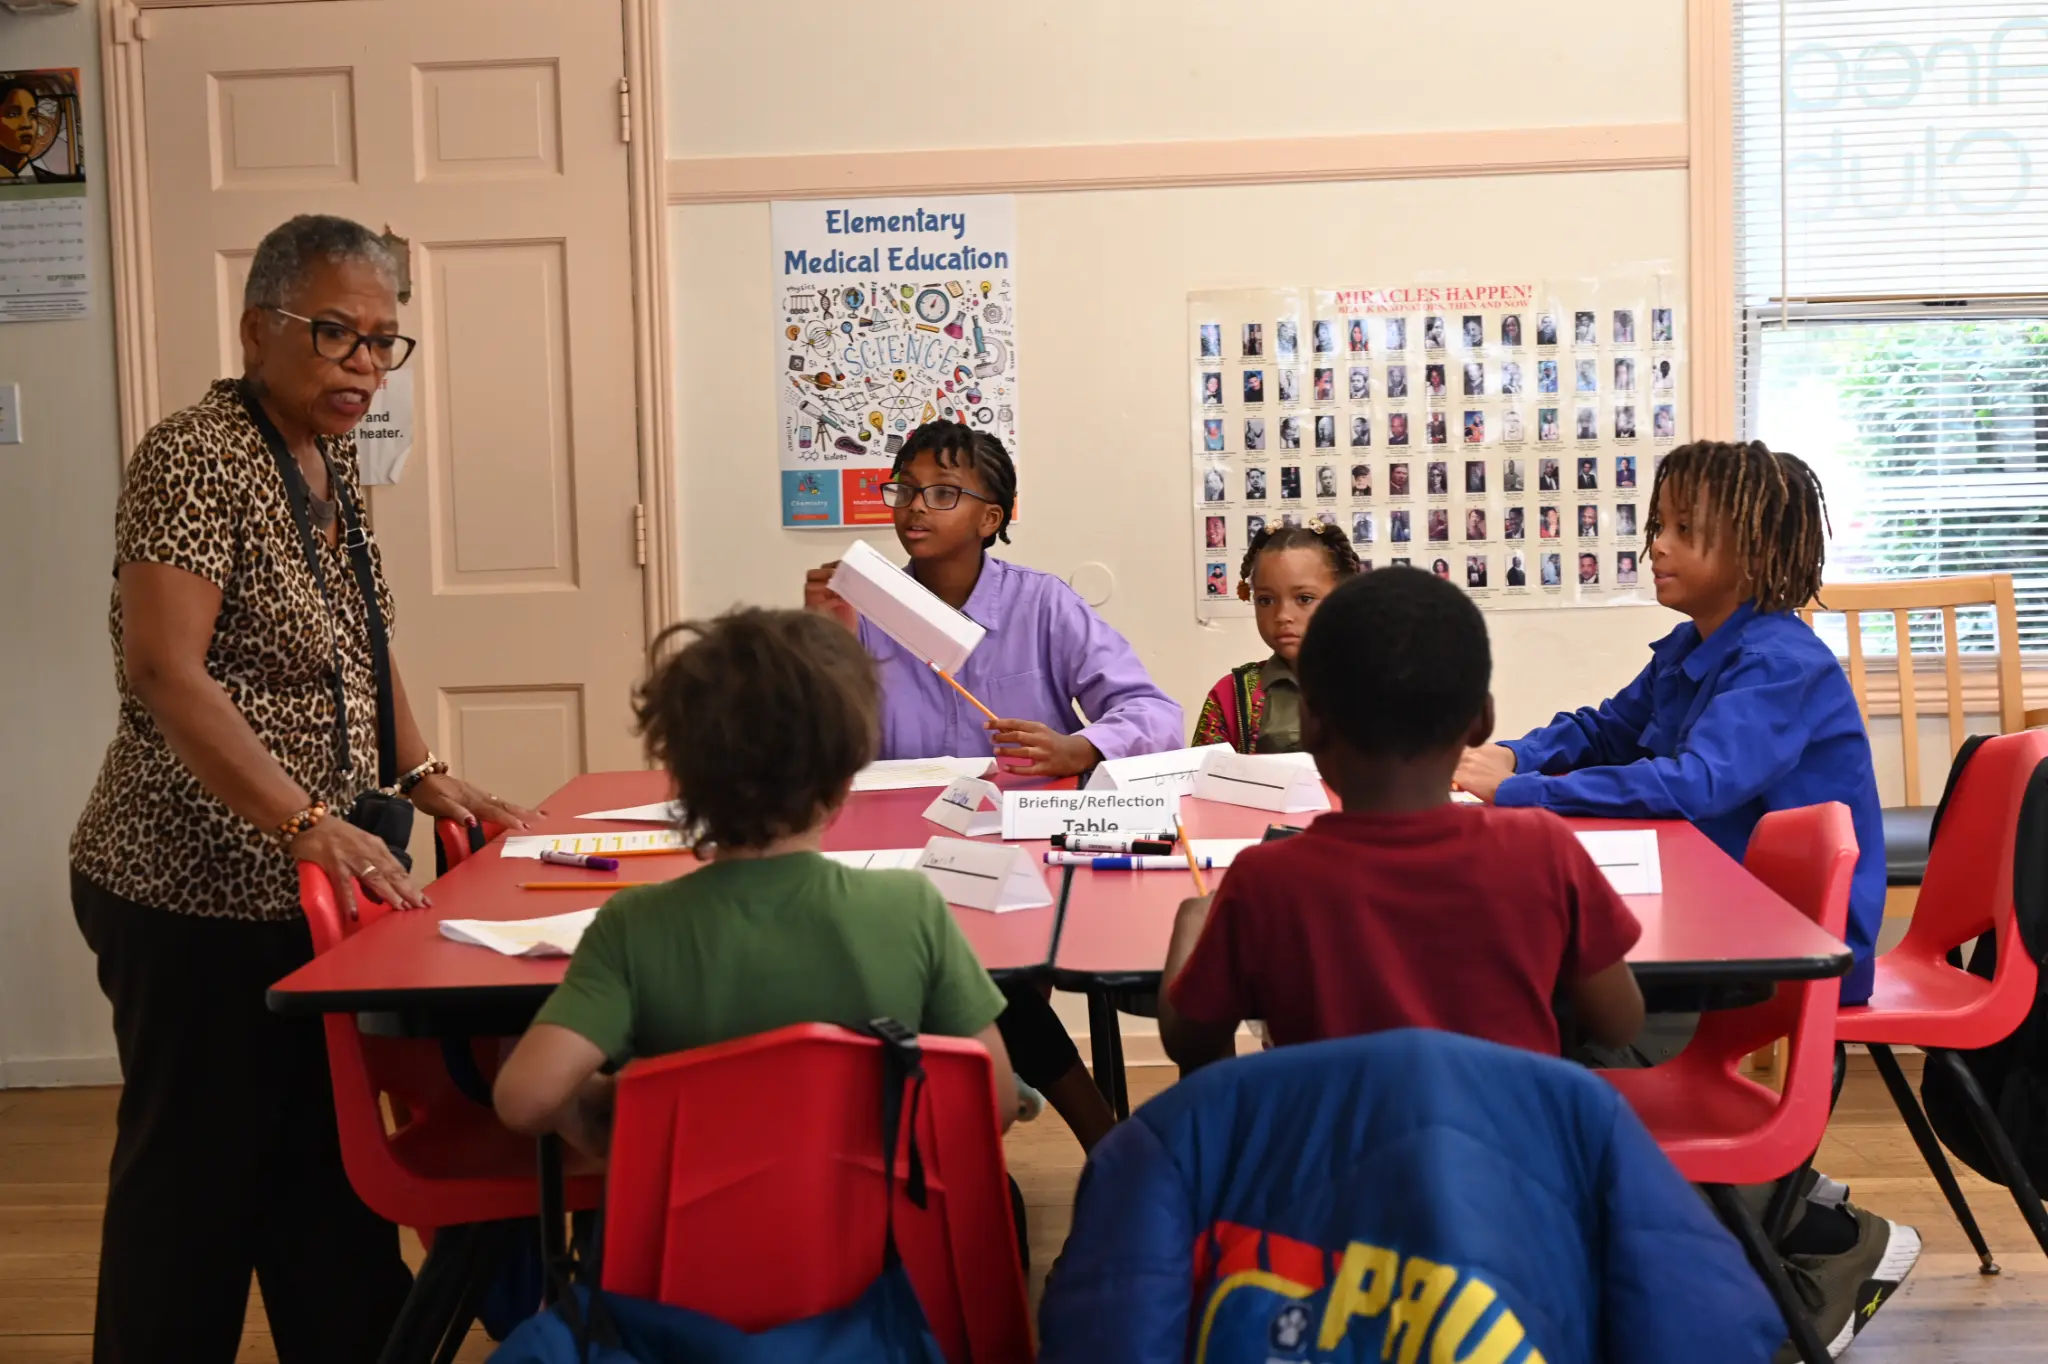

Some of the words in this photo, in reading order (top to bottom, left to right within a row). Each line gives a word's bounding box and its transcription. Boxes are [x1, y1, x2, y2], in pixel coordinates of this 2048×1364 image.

[826, 207, 965, 239] Elementary
[784, 248, 880, 275] Medical
[888, 246, 1009, 272] Education
[1445, 284, 1533, 302] HAPPEN!
[1338, 303, 1374, 314] BLAK
[1449, 301, 1478, 311] THEN
[1480, 300, 1502, 309] AND
[1503, 299, 1529, 308] NOW
[844, 333, 960, 377] SCIENCE
[365, 411, 390, 422] and
[359, 428, 404, 440] heater.
[790, 500, 828, 508] Chemistry
[1019, 794, 1165, 812] Briefing/Reflection
[1063, 818, 1119, 835] Table
